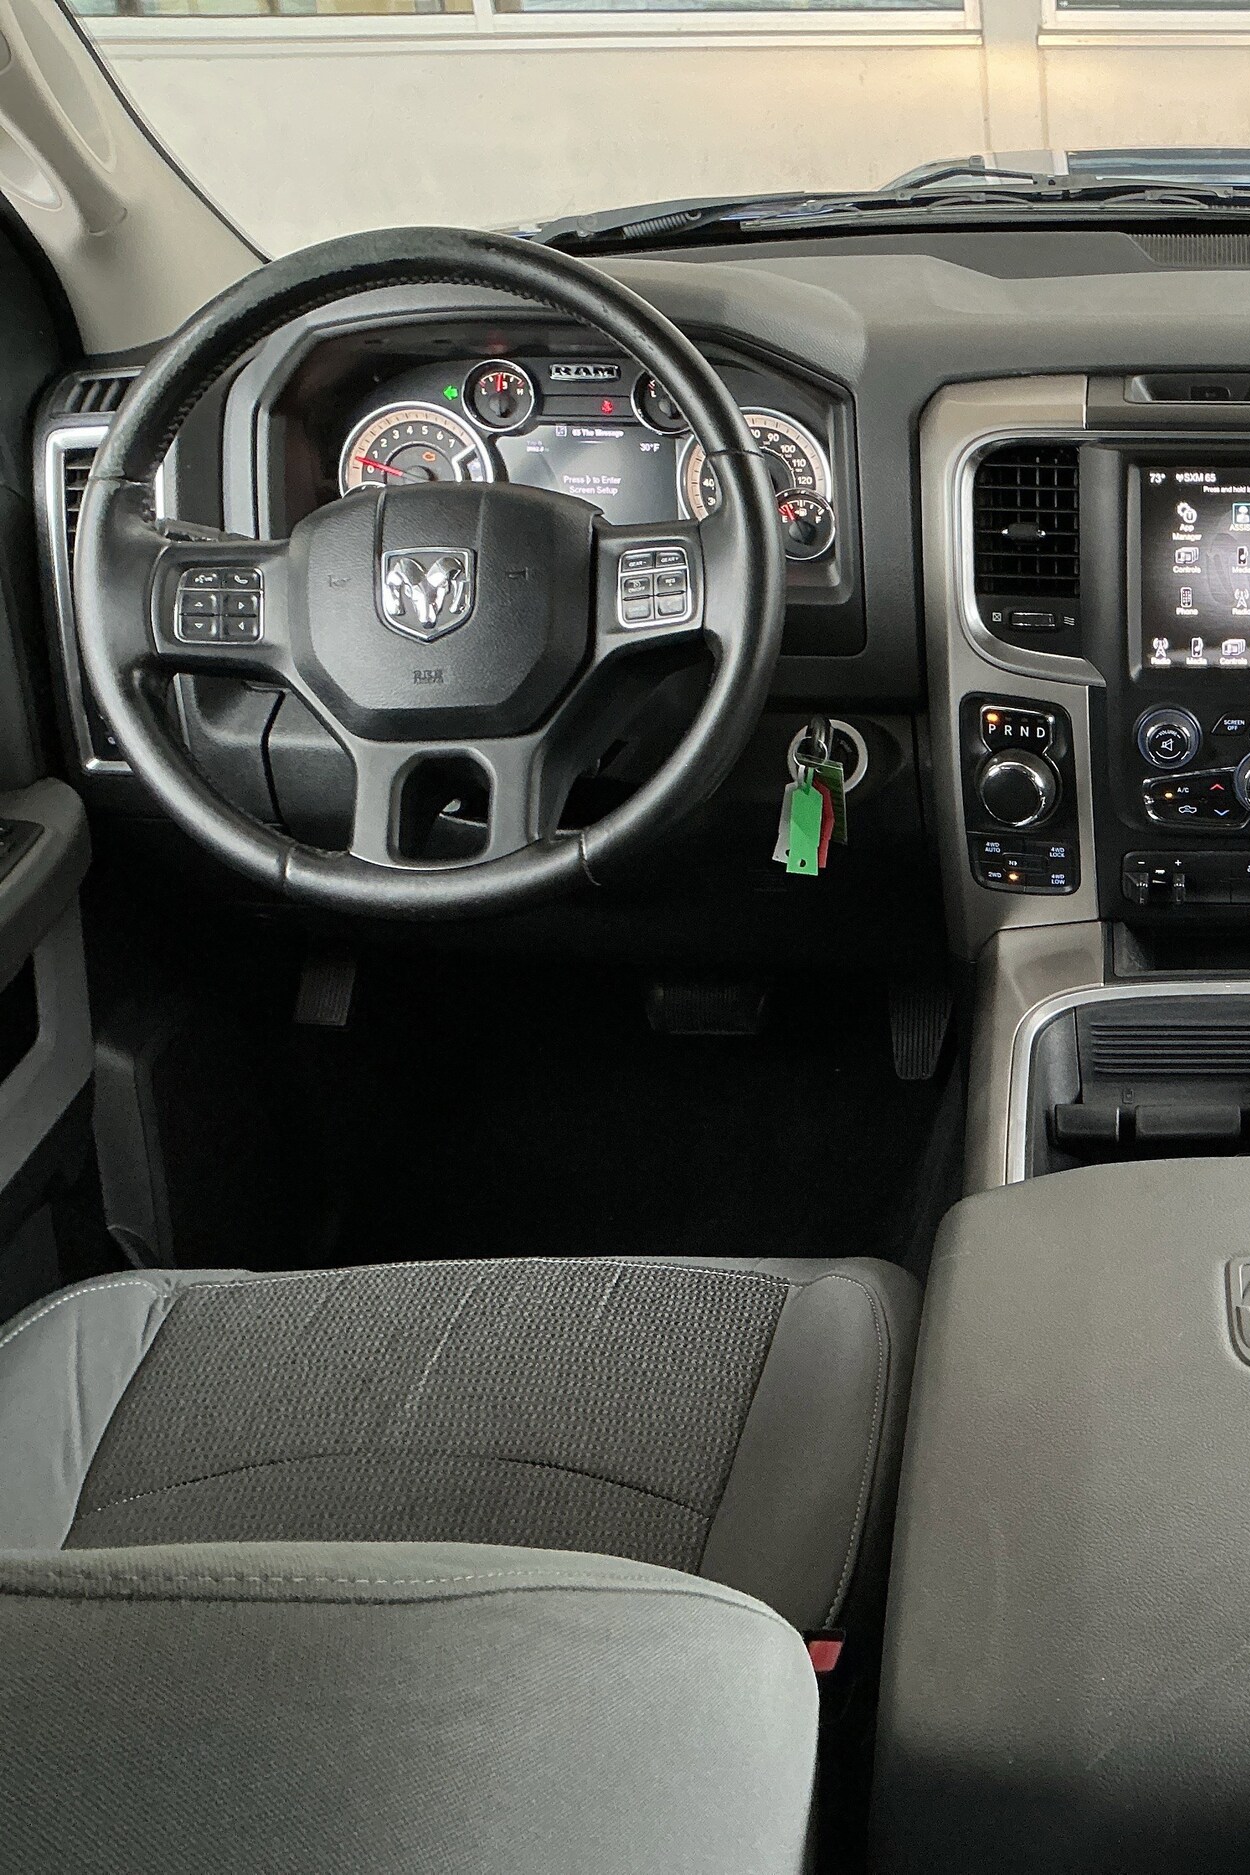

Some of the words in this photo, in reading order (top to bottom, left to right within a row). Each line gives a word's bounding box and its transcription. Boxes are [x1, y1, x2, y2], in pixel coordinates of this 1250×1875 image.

[555, 366, 614, 377] RAM
[392, 430, 400, 440] 3
[406, 426, 414, 435] 4
[421, 426, 428, 435] 5
[436, 431, 444, 440] 6
[767, 432, 780, 442] 90
[380, 438, 388, 448] 2
[448, 438, 456, 448] 7
[780, 444, 796, 454] 100
[372, 450, 379, 459] 1
[792, 458, 806, 468] 110
[366, 465, 375, 474] 0
[563, 475, 584, 484] Press
[601, 475, 622, 484] Enter
[798, 476, 812, 485] 120
[1183, 472, 1204, 483] SXM
[1204, 472, 1216, 483] 65
[569, 486, 596, 495] Screen
[596, 486, 618, 497] Setup
[988, 724, 996, 734] P
[1004, 724, 1012, 736] R
[1020, 726, 1030, 737] N
[1036, 726, 1046, 738] D
